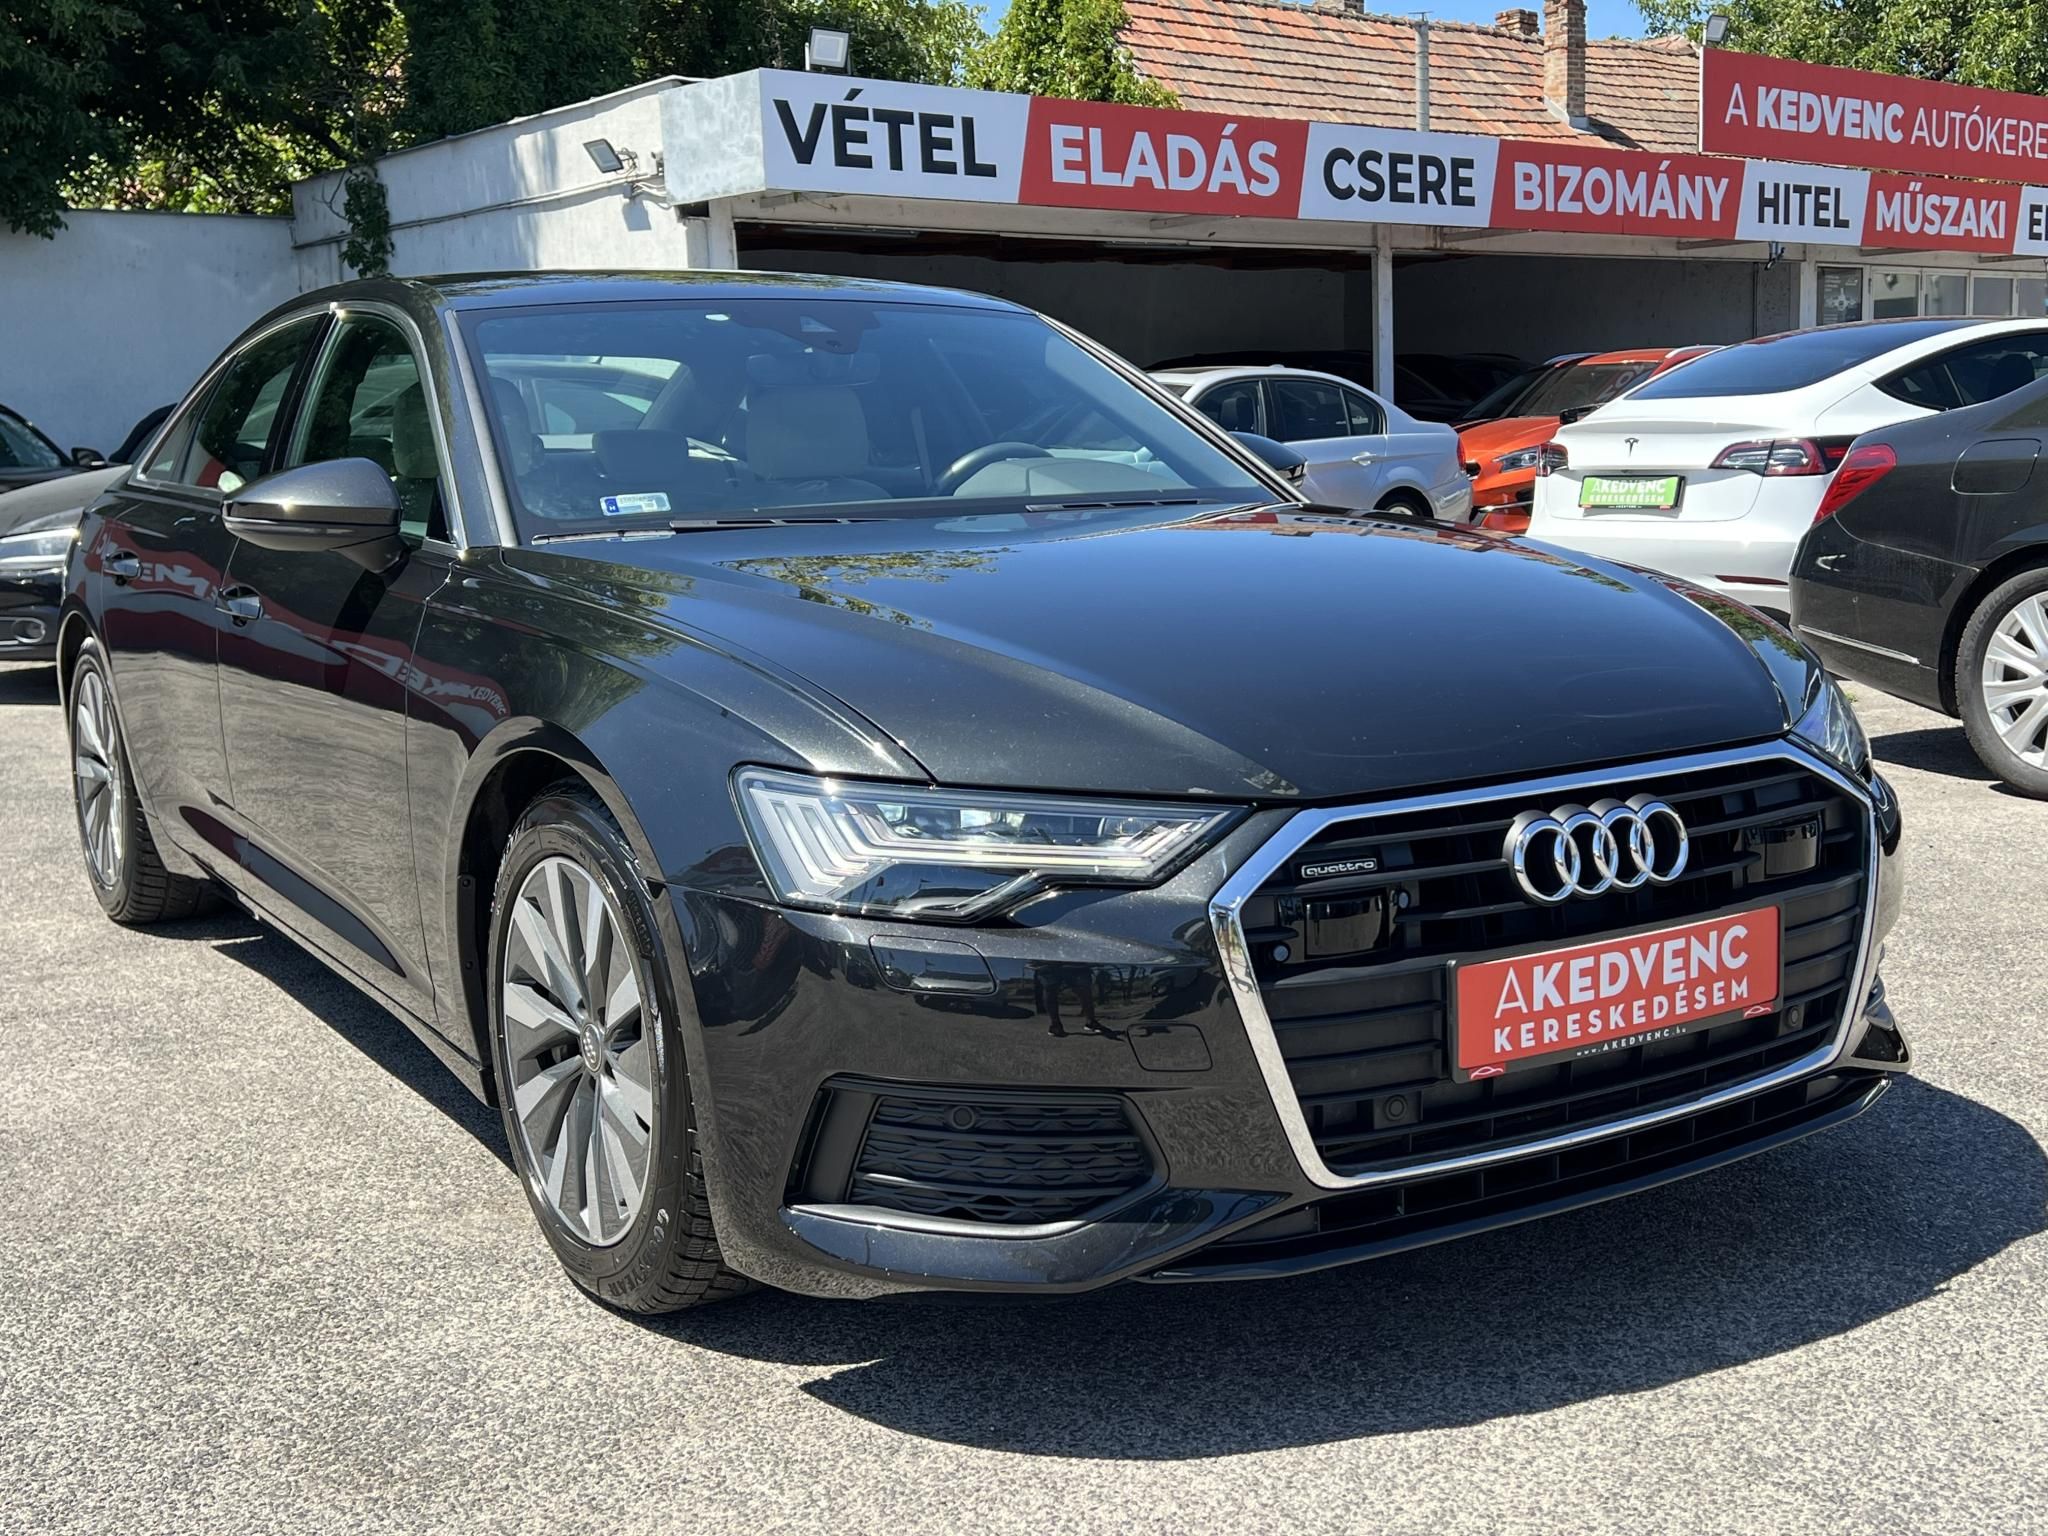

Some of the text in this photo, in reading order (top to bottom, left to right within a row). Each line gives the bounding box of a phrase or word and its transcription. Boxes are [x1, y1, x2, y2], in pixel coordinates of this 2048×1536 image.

[773, 88, 997, 177] VÉTEL
[1725, 83, 1748, 126] A
[1757, 86, 1905, 144] KEDVENC
[1050, 123, 1280, 198] ELADÁS
[1323, 147, 1476, 207] CSERE
[1514, 160, 1729, 221] BIZOMÁNY
[1758, 181, 1850, 229] HITEL
[1876, 182, 2006, 239] MŰSZAKI
[2028, 204, 2048, 241] E
[1306, 861, 1375, 877] quattro
[1494, 976, 1749, 1053] KERESKEDÉSEM
